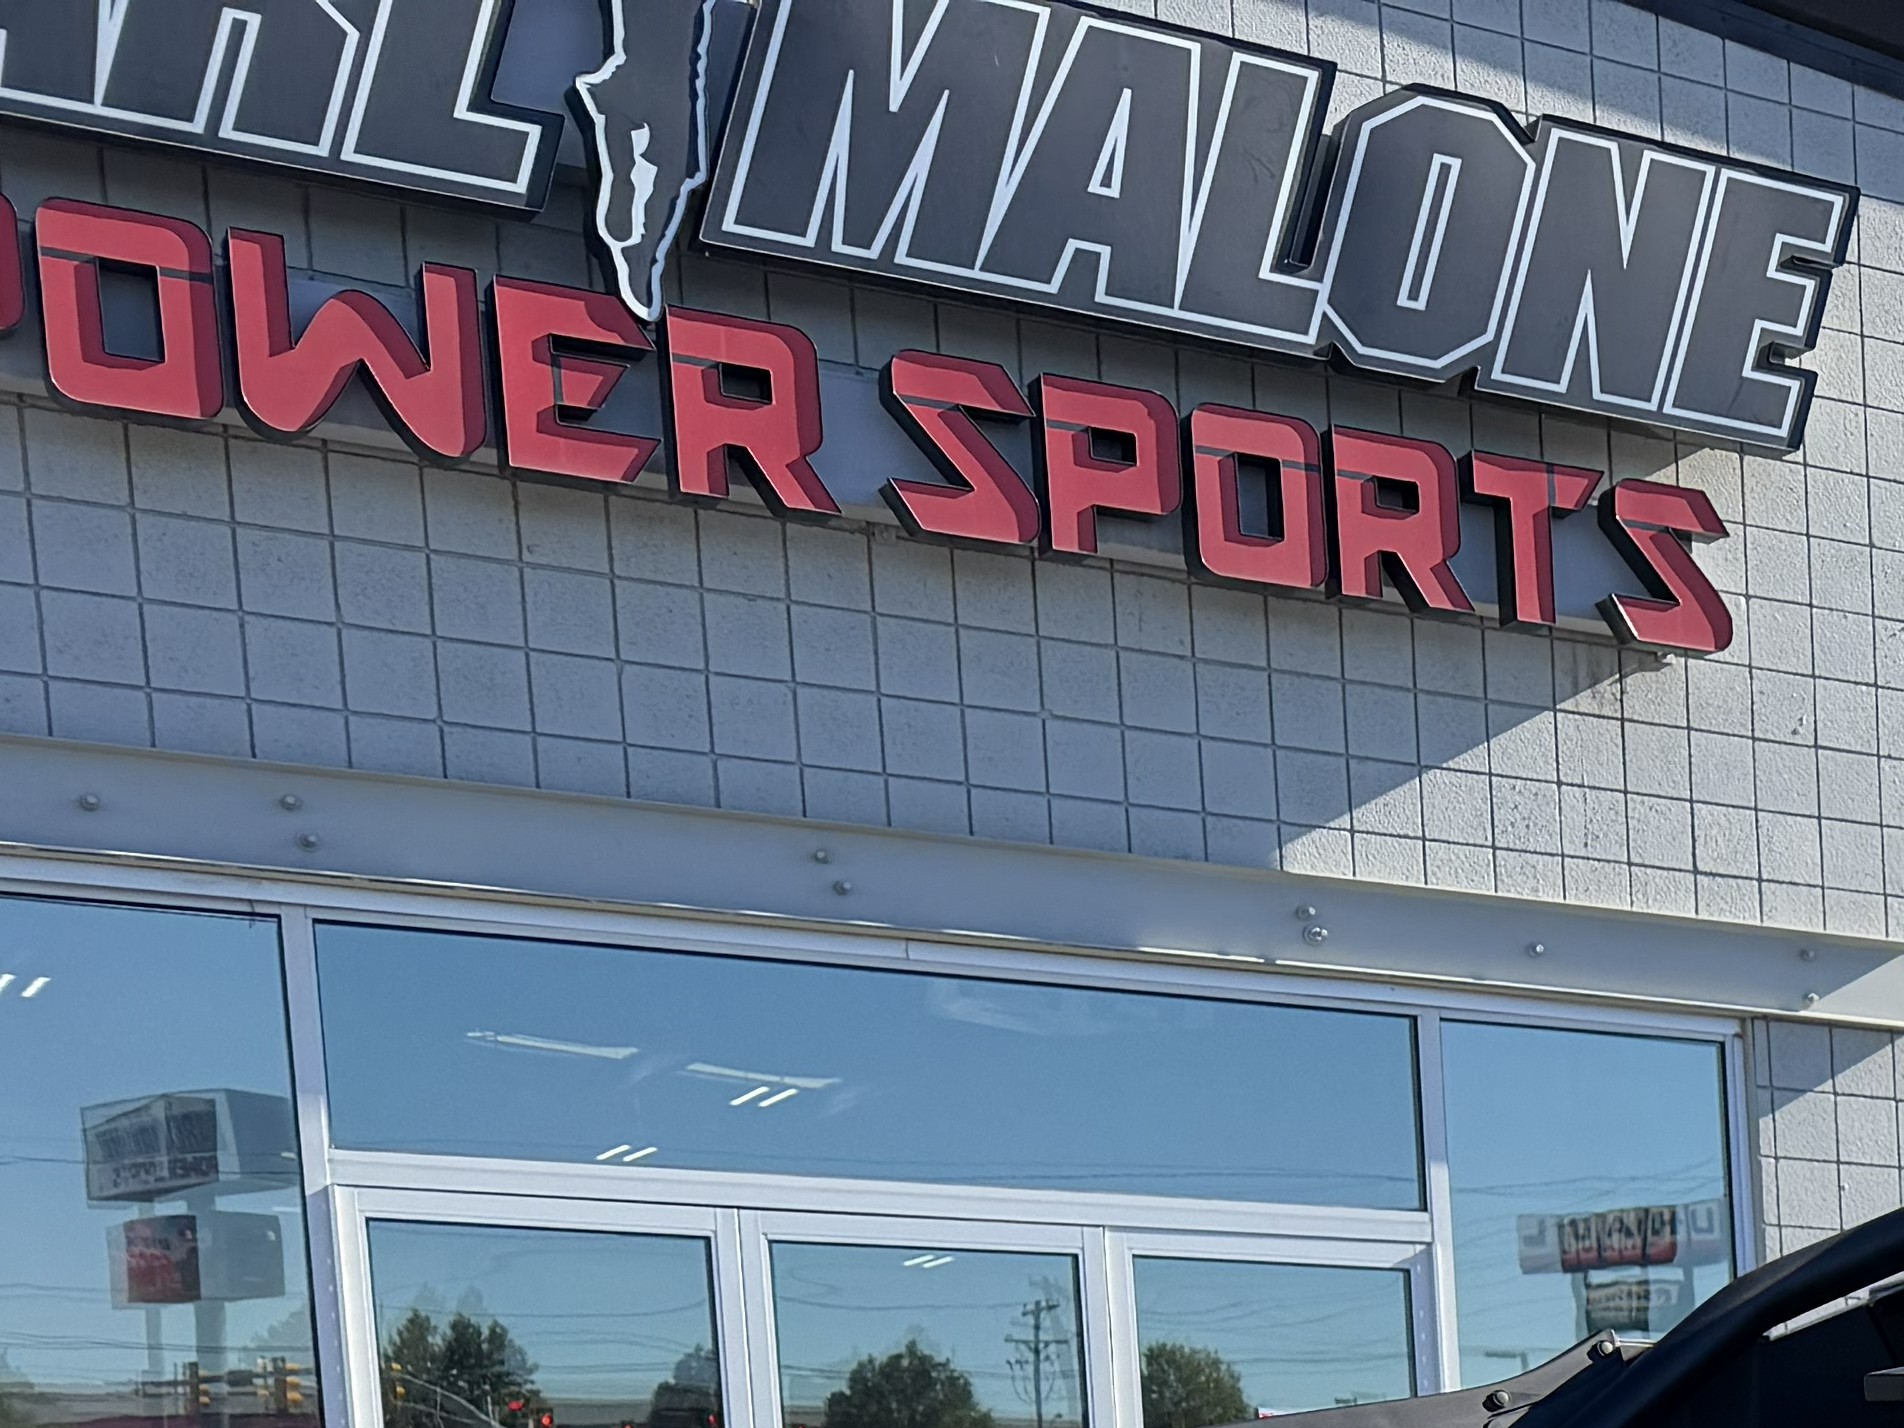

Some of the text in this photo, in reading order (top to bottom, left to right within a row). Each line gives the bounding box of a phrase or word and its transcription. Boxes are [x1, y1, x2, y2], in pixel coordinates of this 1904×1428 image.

[0, 196, 1733, 652] OWER SPORTS
[705, 0, 1856, 449] MALONE
